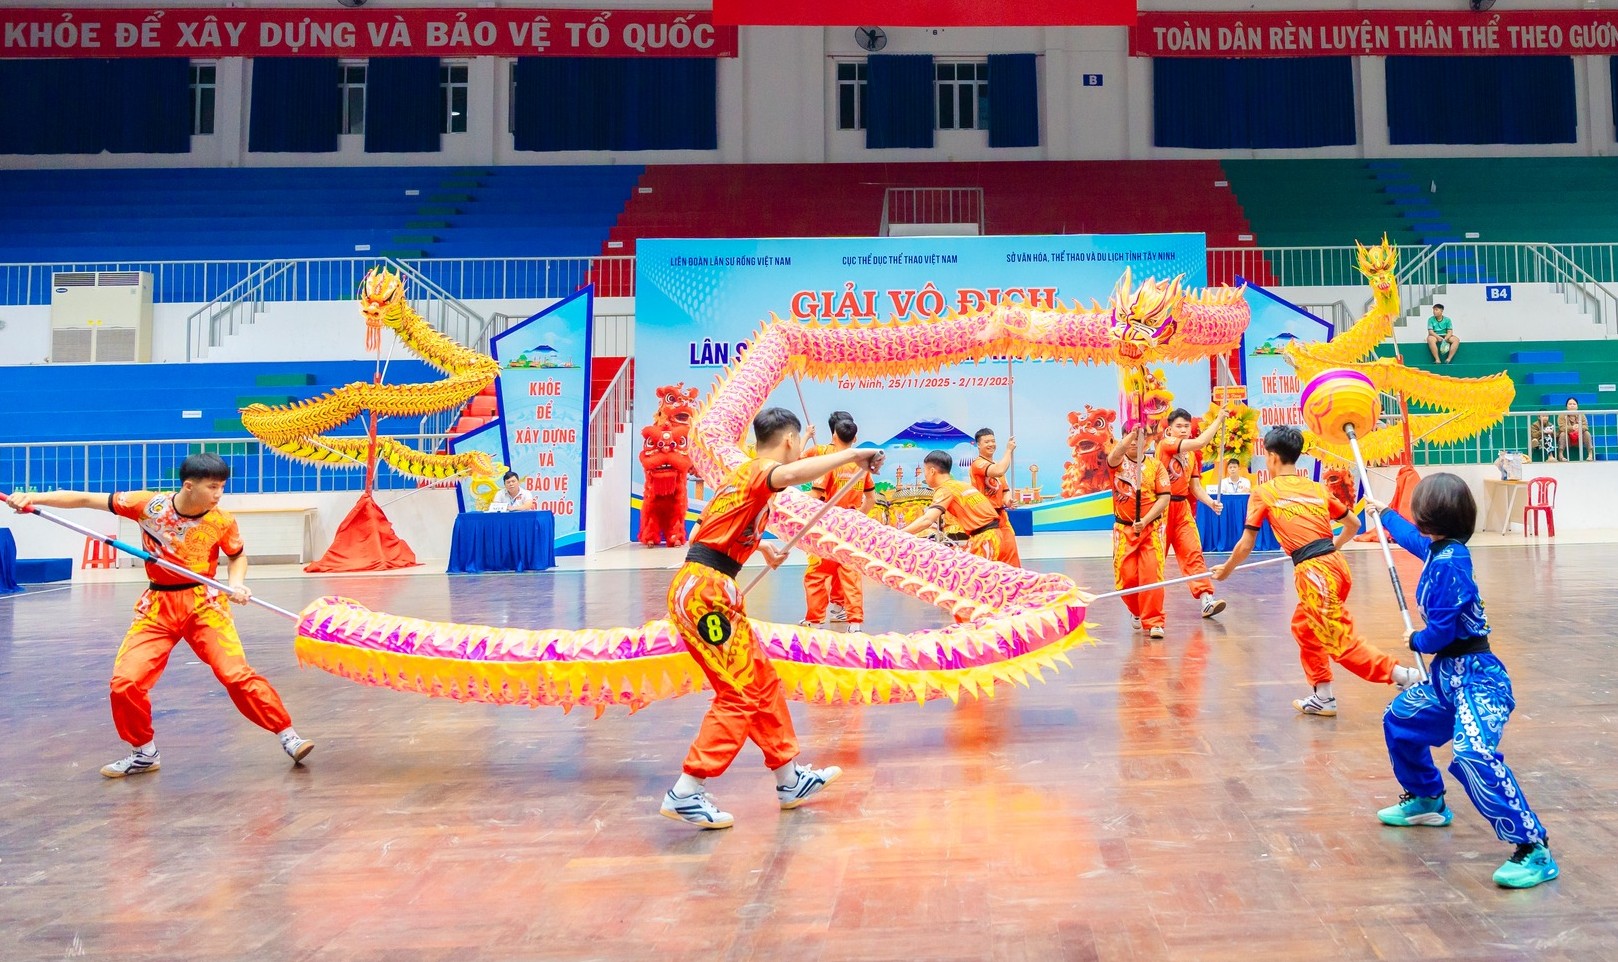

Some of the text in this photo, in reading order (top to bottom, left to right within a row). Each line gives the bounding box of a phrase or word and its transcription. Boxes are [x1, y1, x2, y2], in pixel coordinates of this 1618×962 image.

[4, 10, 715, 53] KHỎE ĐỂ XÂY DỰNG VÀ BẢO VỆ TỔ QUỐC
[1153, 20, 1211, 51] TOÀN
[1218, 21, 1262, 50] DÂN
[1269, 20, 1313, 50] RÈN
[1320, 19, 1389, 53] LUYỆN
[1394, 19, 1452, 49] THÂN
[1458, 14, 1500, 49] THỂ
[1507, 25, 1563, 49] THEO
[1089, 75, 1098, 85] B
[757, 256, 773, 267] VIỆT
[774, 257, 792, 266] NAM
[842, 256, 857, 267] CỤC
[904, 255, 923, 264] THAO
[924, 254, 940, 265] VIỆT
[941, 255, 958, 264] NAM
[1066, 252, 1085, 261] THAO
[1086, 251, 1096, 261] VÀ
[1097, 252, 1107, 261] DU
[1158, 252, 1176, 260] NINH
[791, 281, 877, 319] GIẢI
[887, 281, 945, 318] VÔ
[1490, 287, 1508, 299] B4
[689, 337, 729, 365] LÂN
[529, 377, 561, 396] KHỎE
[837, 379, 856, 390] Tây
[858, 378, 885, 390] Ninh,
[888, 377, 950, 389] 25/11/2025
[958, 376, 1014, 387] 2/12/2025
[1261, 368, 1278, 394] THỂ
[1278, 375, 1300, 394] THAO
[536, 399, 553, 420] ĐỂ
[1261, 403, 1285, 426] ĐOÀN
[515, 426, 576, 447] XÂY DỰNG
[539, 449, 555, 467] VÀ
[526, 472, 568, 494] BẢO VỆ
[706, 614, 723, 642] 8
